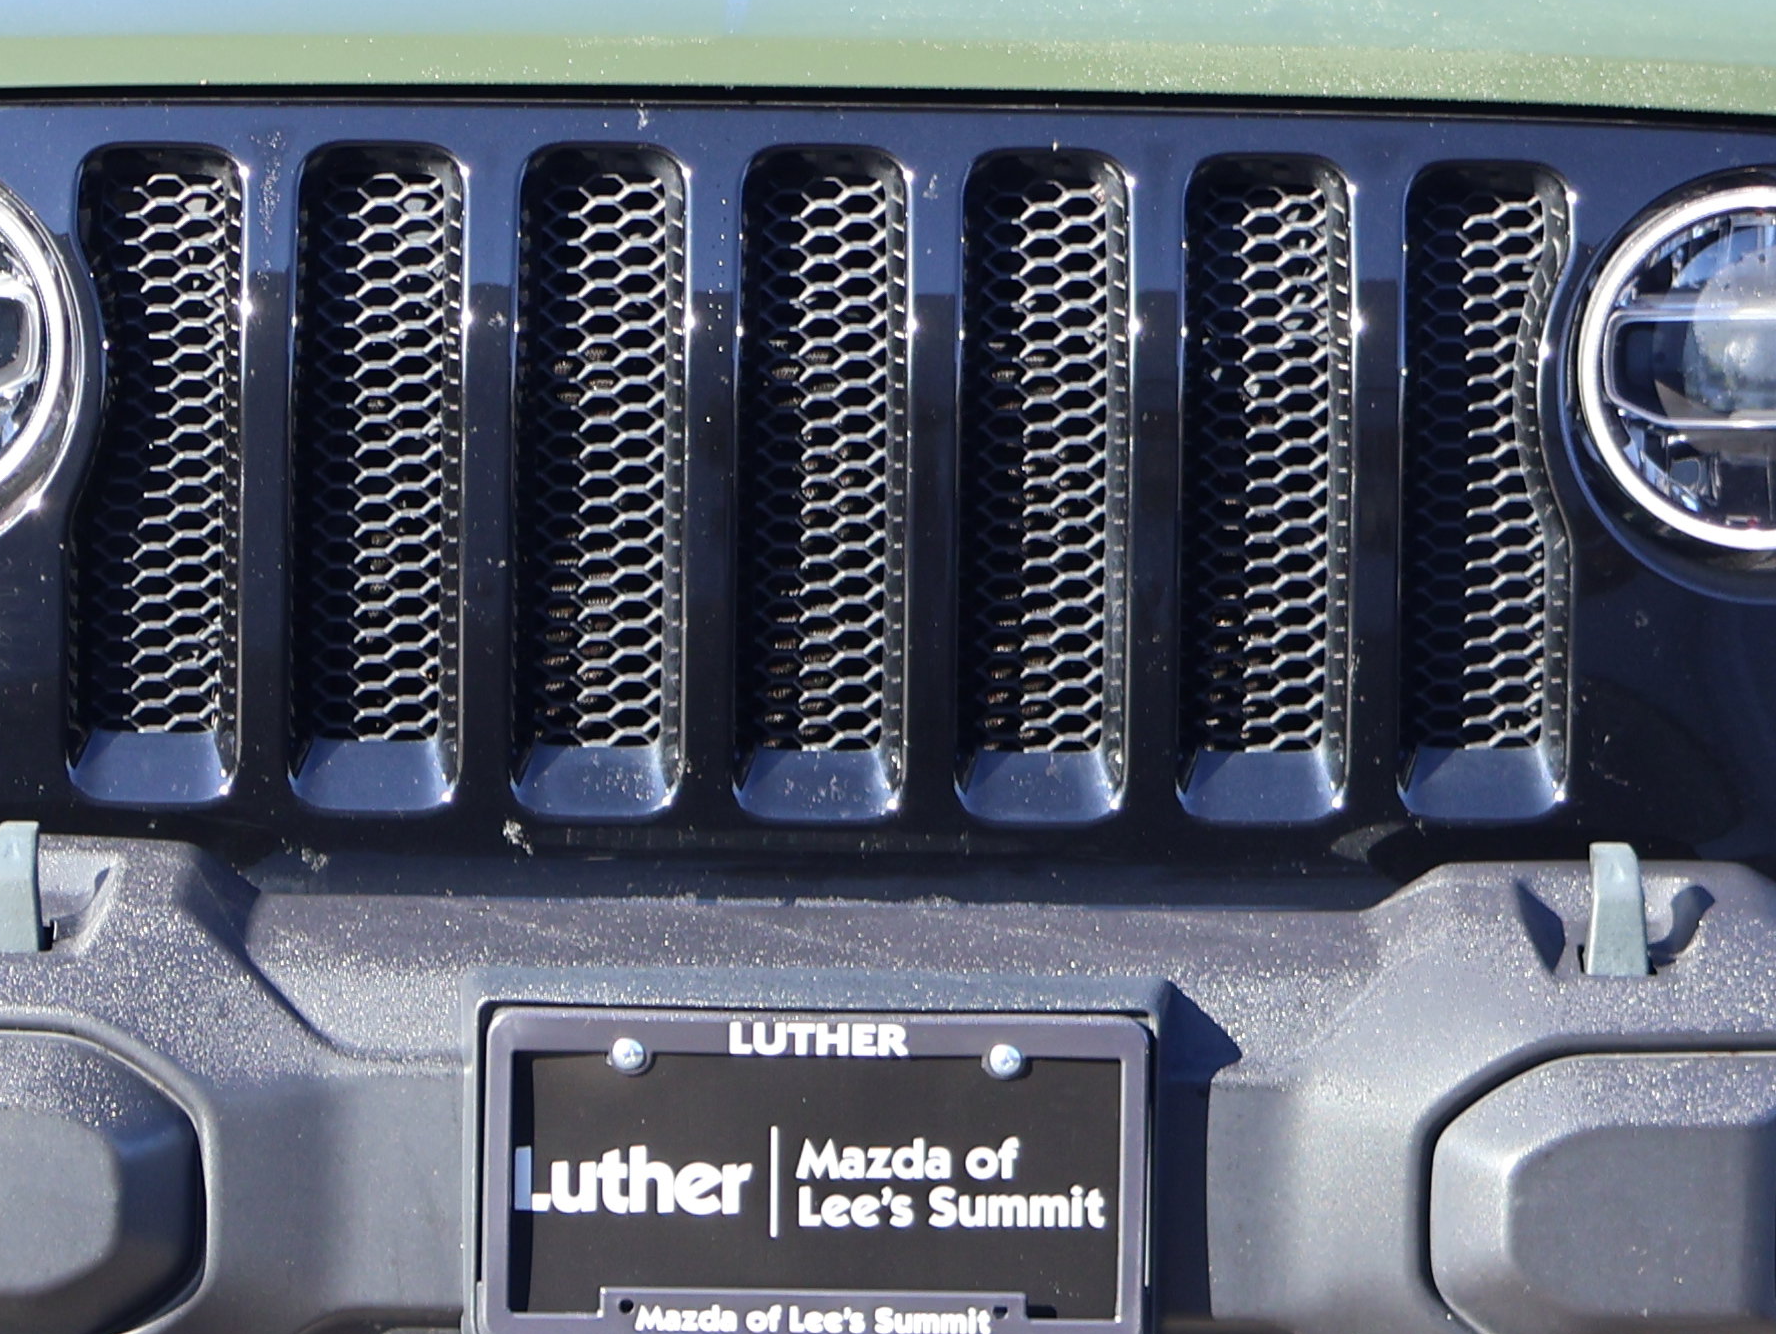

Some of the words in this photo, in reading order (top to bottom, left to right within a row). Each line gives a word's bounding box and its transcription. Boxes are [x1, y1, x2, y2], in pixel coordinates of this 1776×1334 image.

[729, 1021, 909, 1057] LUTHER
[795, 1138, 952, 1180] Mazda
[966, 1137, 1020, 1180] of
[514, 1145, 754, 1216] Luther
[798, 1186, 915, 1228] Lee's
[928, 1185, 1106, 1229] Summit
[634, 1304, 738, 1333] Mazda
[745, 1304, 783, 1334] of
[788, 1305, 867, 1334] Lee's
